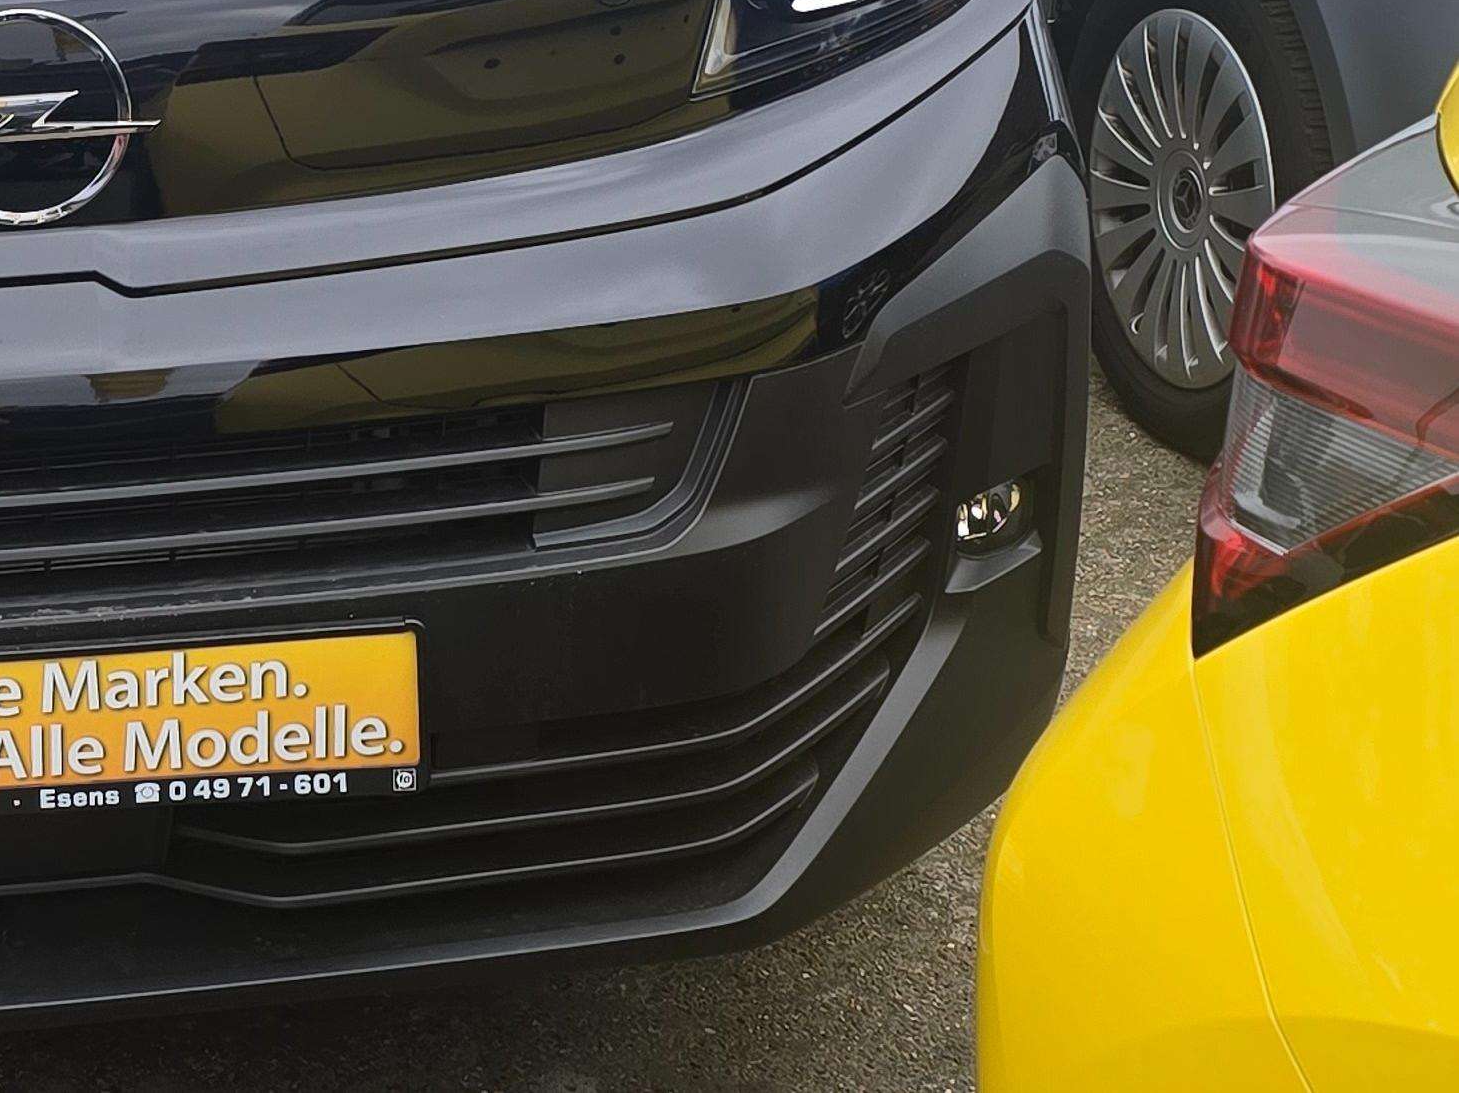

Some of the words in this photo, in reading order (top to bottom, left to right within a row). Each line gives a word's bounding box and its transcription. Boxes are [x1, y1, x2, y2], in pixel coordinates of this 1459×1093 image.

[42, 650, 308, 713] Marken.
[124, 704, 403, 772] Modelle.
[39, 788, 120, 810] Esens
